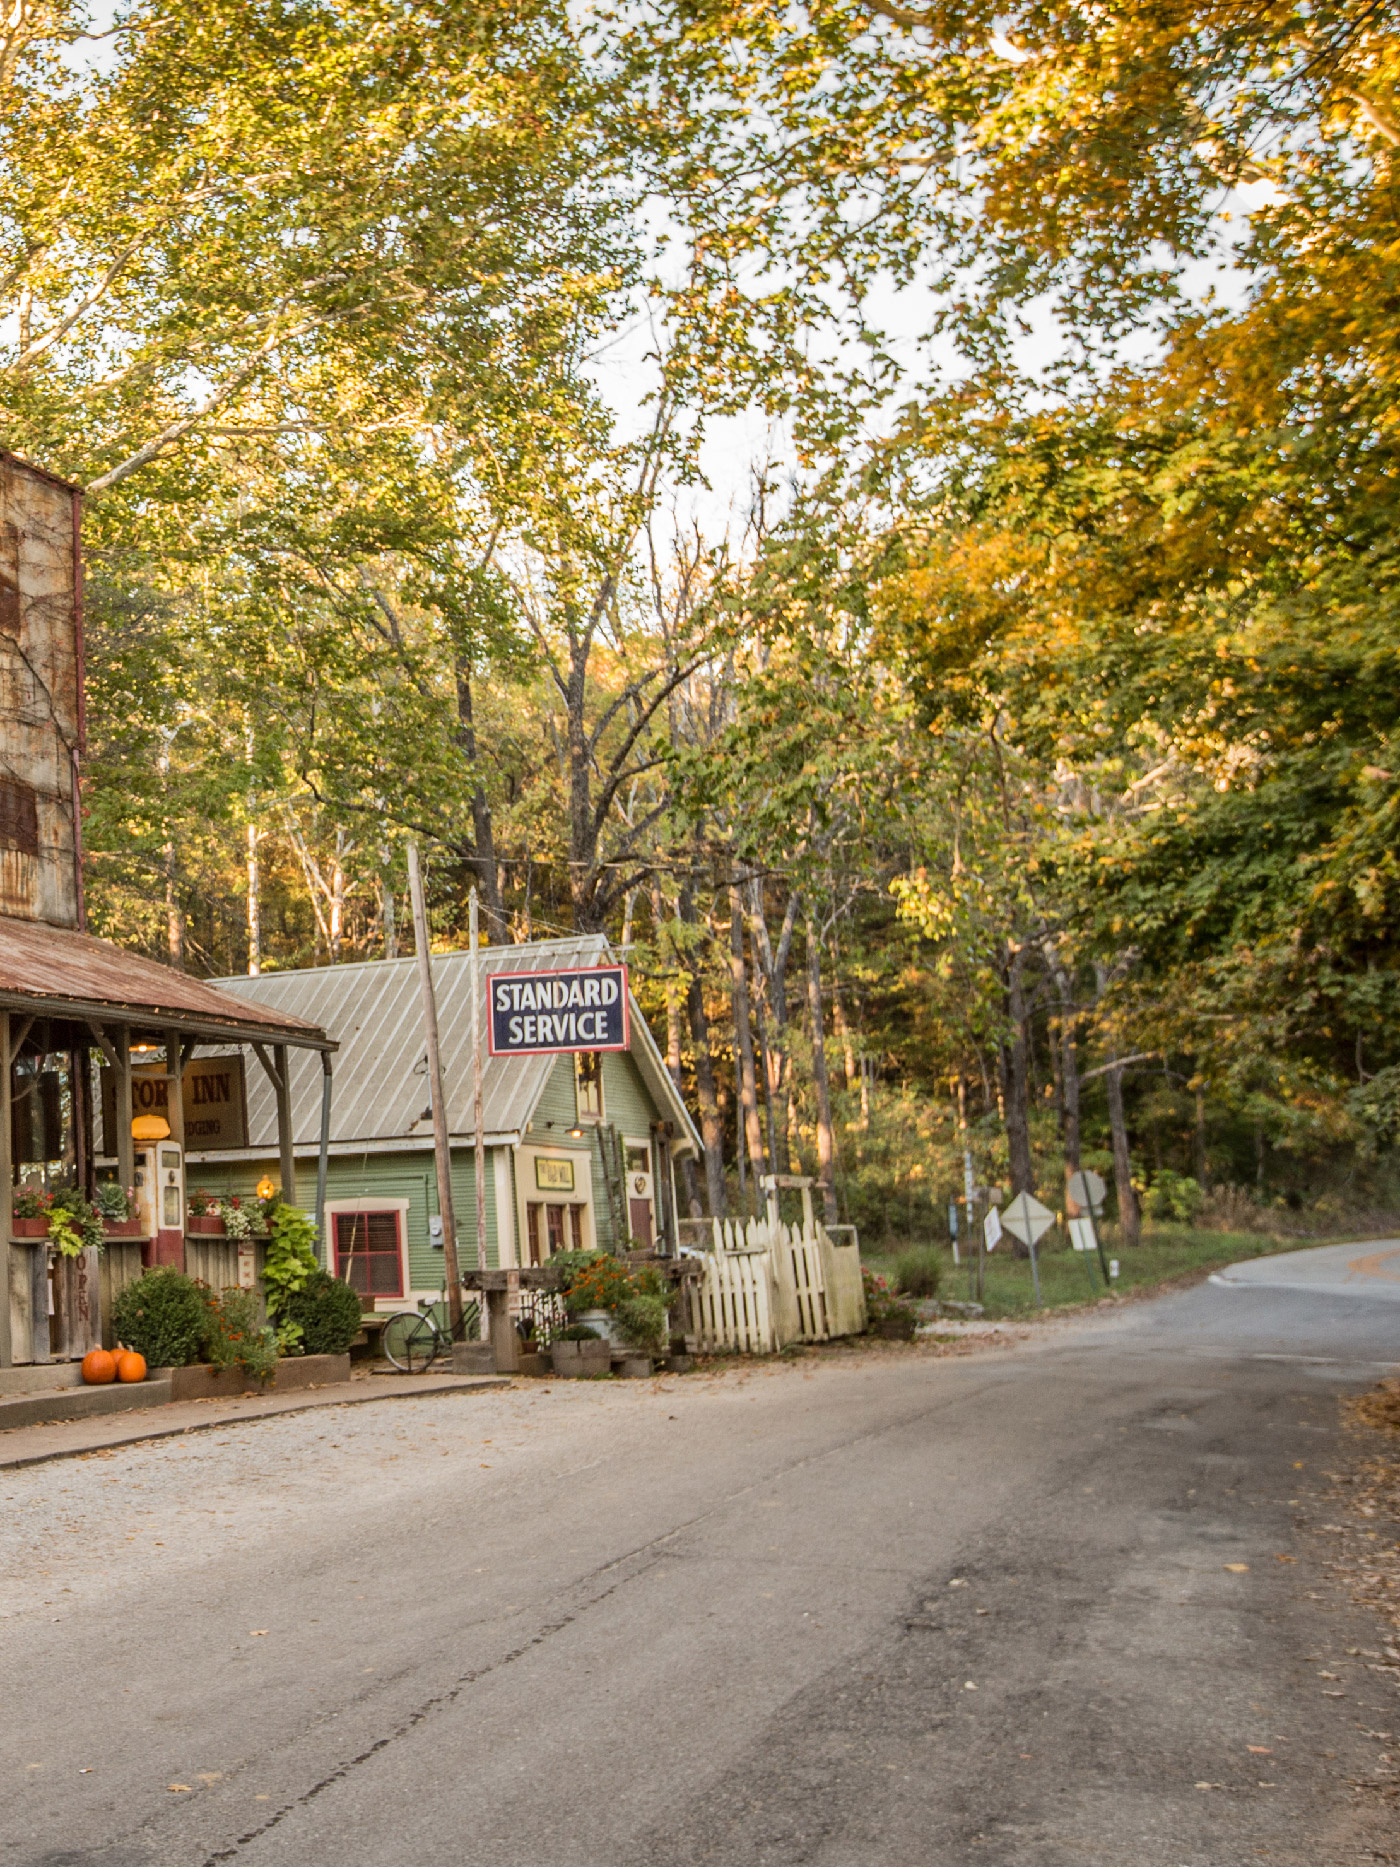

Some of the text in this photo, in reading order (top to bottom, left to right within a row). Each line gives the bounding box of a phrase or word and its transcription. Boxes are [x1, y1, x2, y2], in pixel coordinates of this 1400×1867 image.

[496, 977, 619, 1012] STANDARD
[508, 1010, 609, 1044] SERVICE
[192, 1073, 231, 1105] INN
[76, 1252, 89, 1321] OPEN
